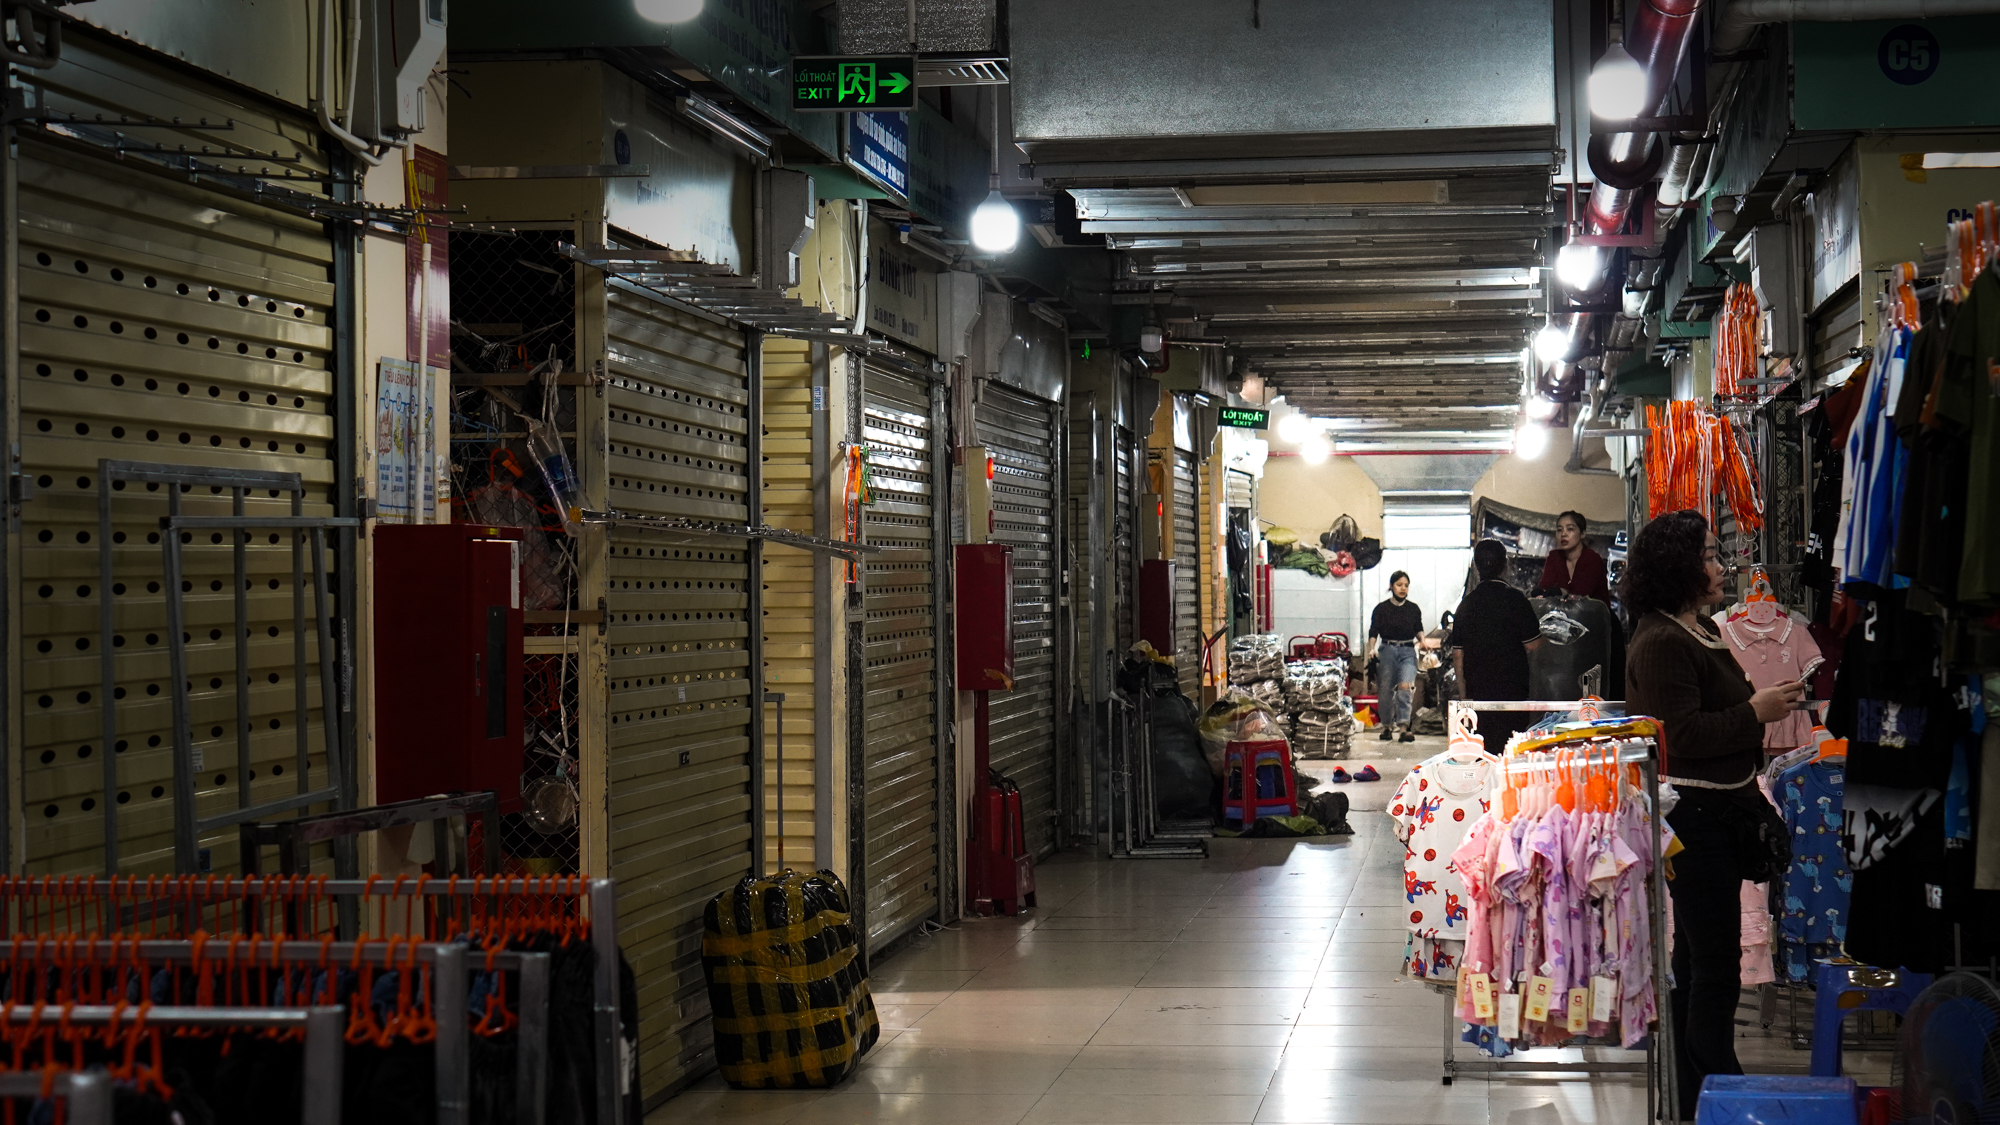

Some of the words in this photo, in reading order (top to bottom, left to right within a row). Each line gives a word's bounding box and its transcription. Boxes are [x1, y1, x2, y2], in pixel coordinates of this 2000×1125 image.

[1887, 38, 1930, 71] C5
[795, 69, 808, 82] LỐI
[810, 70, 836, 83] THOÁT
[798, 88, 833, 99] EXIT
[879, 242, 900, 292] BÌNH
[1238, 411, 1264, 422] THOÁT
